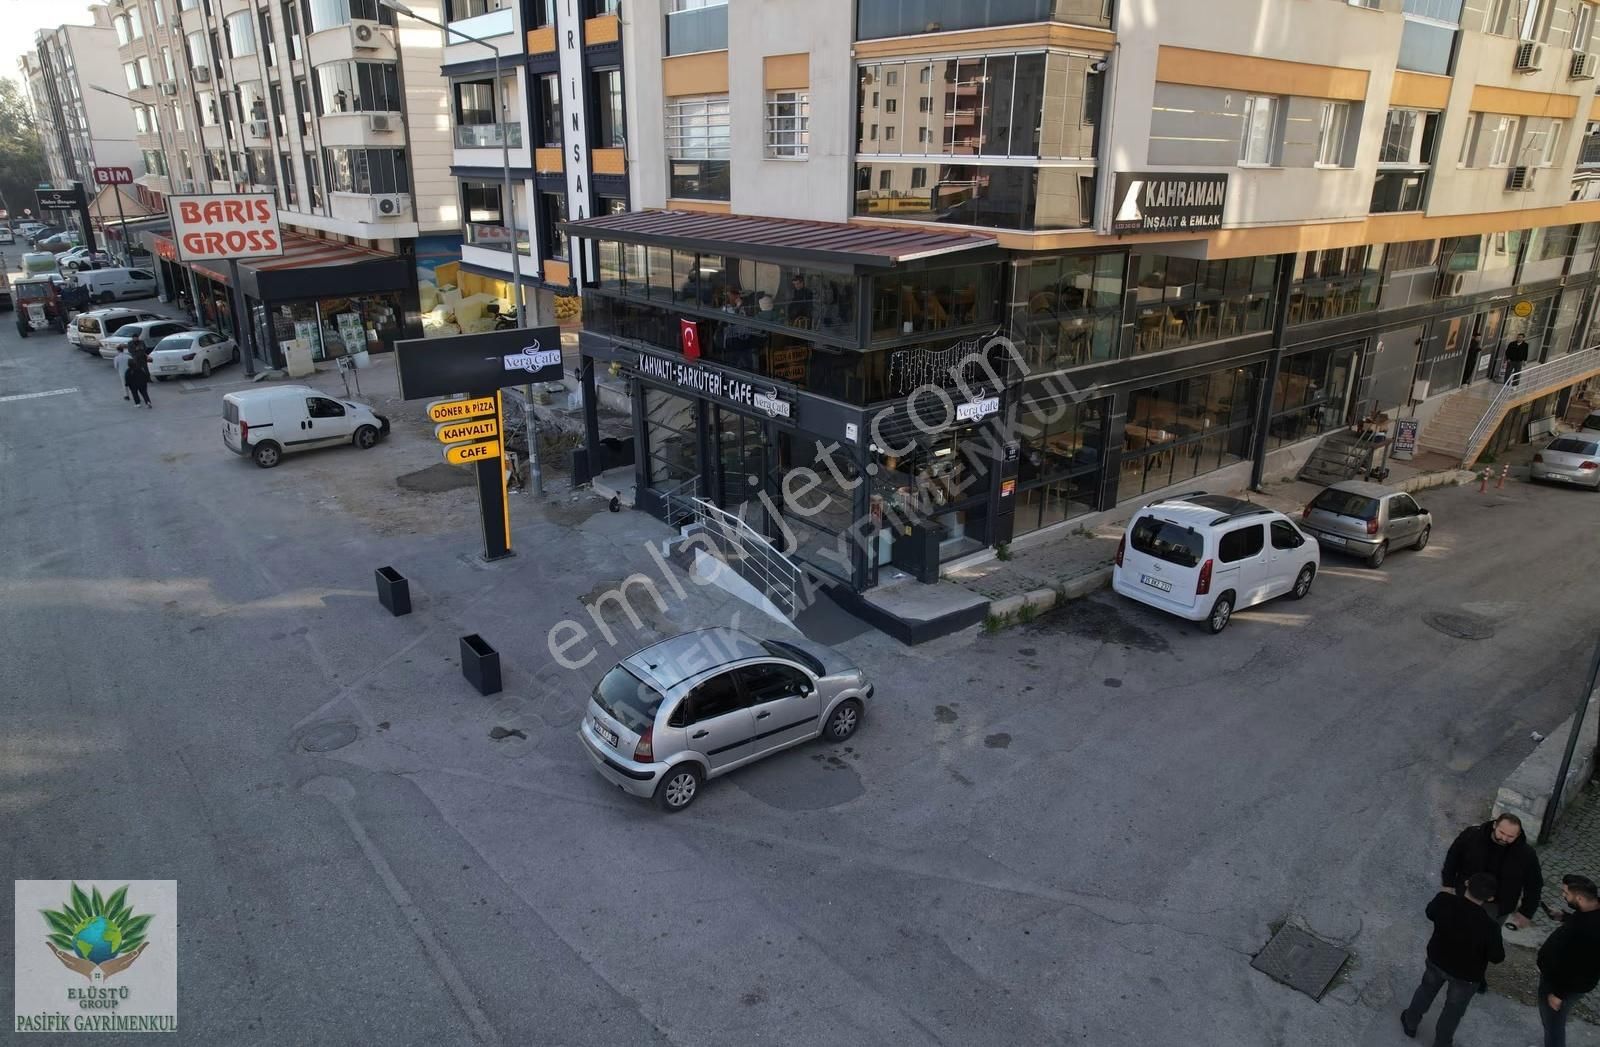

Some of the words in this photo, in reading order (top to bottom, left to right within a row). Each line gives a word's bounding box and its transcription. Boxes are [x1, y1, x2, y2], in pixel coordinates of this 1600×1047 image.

[571, 77, 584, 220] İNŞAA
[97, 168, 130, 182] BİM
[1145, 181, 1225, 207] KAHRAMAN
[179, 199, 272, 225] BARIŞ
[1143, 214, 1179, 231] İNŞAAT
[1180, 216, 1187, 226] &
[1189, 214, 1221, 226] EMLAK
[182, 229, 278, 256] GROSS
[505, 356, 532, 367] Vera
[639, 353, 673, 380] KAHVALTI
[677, 365, 722, 396] ŞARKÜTERİ
[729, 379, 752, 405] CAFE
[434, 406, 463, 419] DÖNER
[464, 404, 471, 414] &
[472, 401, 494, 413] PİZZA
[958, 406, 978, 417] Vera
[443, 423, 494, 440] KAHVALTI
[460, 446, 487, 459] CAFE
